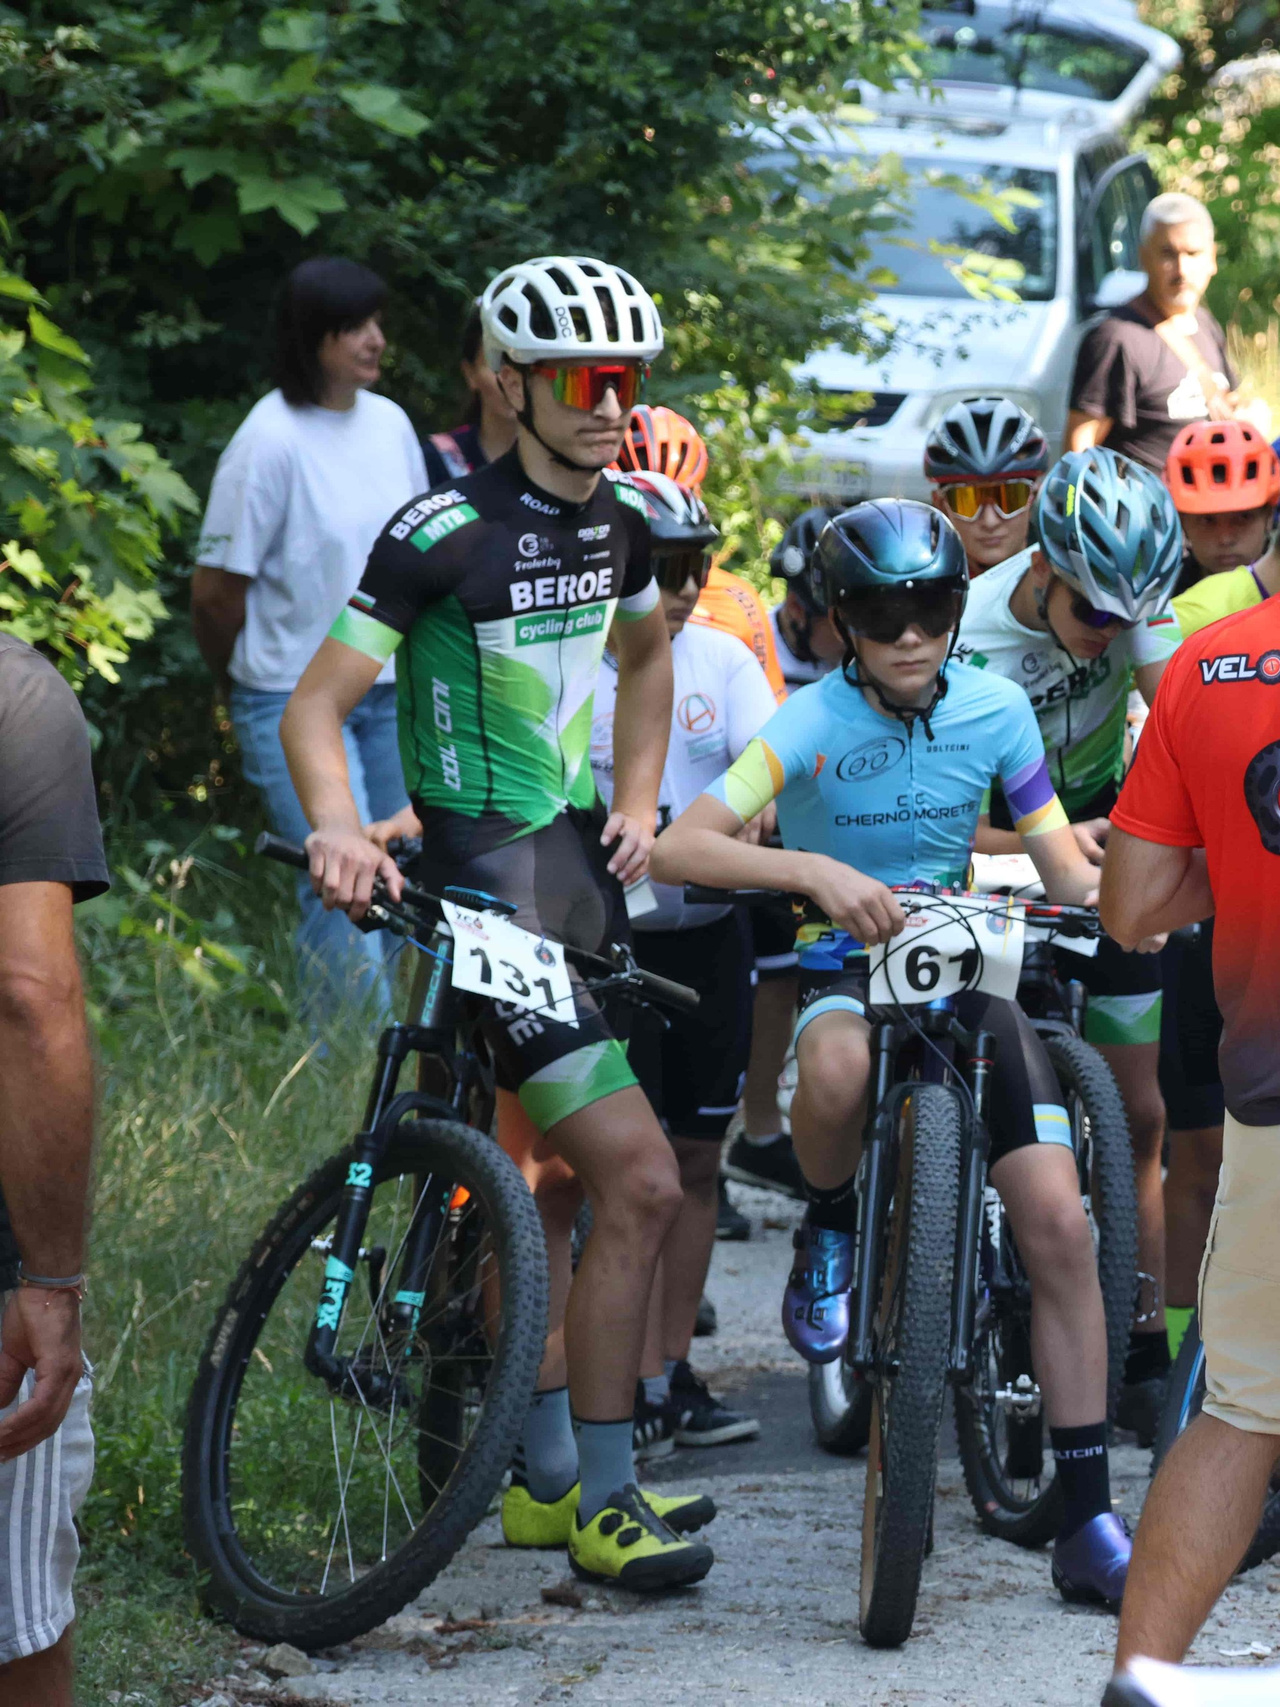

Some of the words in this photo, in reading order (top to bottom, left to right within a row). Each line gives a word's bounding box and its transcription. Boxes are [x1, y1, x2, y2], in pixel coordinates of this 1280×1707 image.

[554, 306, 574, 339] POC
[389, 489, 467, 541] BEROE
[519, 492, 561, 515] ROAD
[422, 508, 467, 541] MTB
[509, 567, 614, 612] BEROE
[519, 619, 574, 640] cycling
[576, 611, 603, 629] club
[835, 809, 911, 827] CHERNO
[914, 800, 976, 820] MORETS
[421, 940, 450, 1029] FOCUS
[905, 945, 980, 992] 61
[316, 1278, 346, 1331] FOX
[1055, 1444, 1104, 1460] LTCINI
